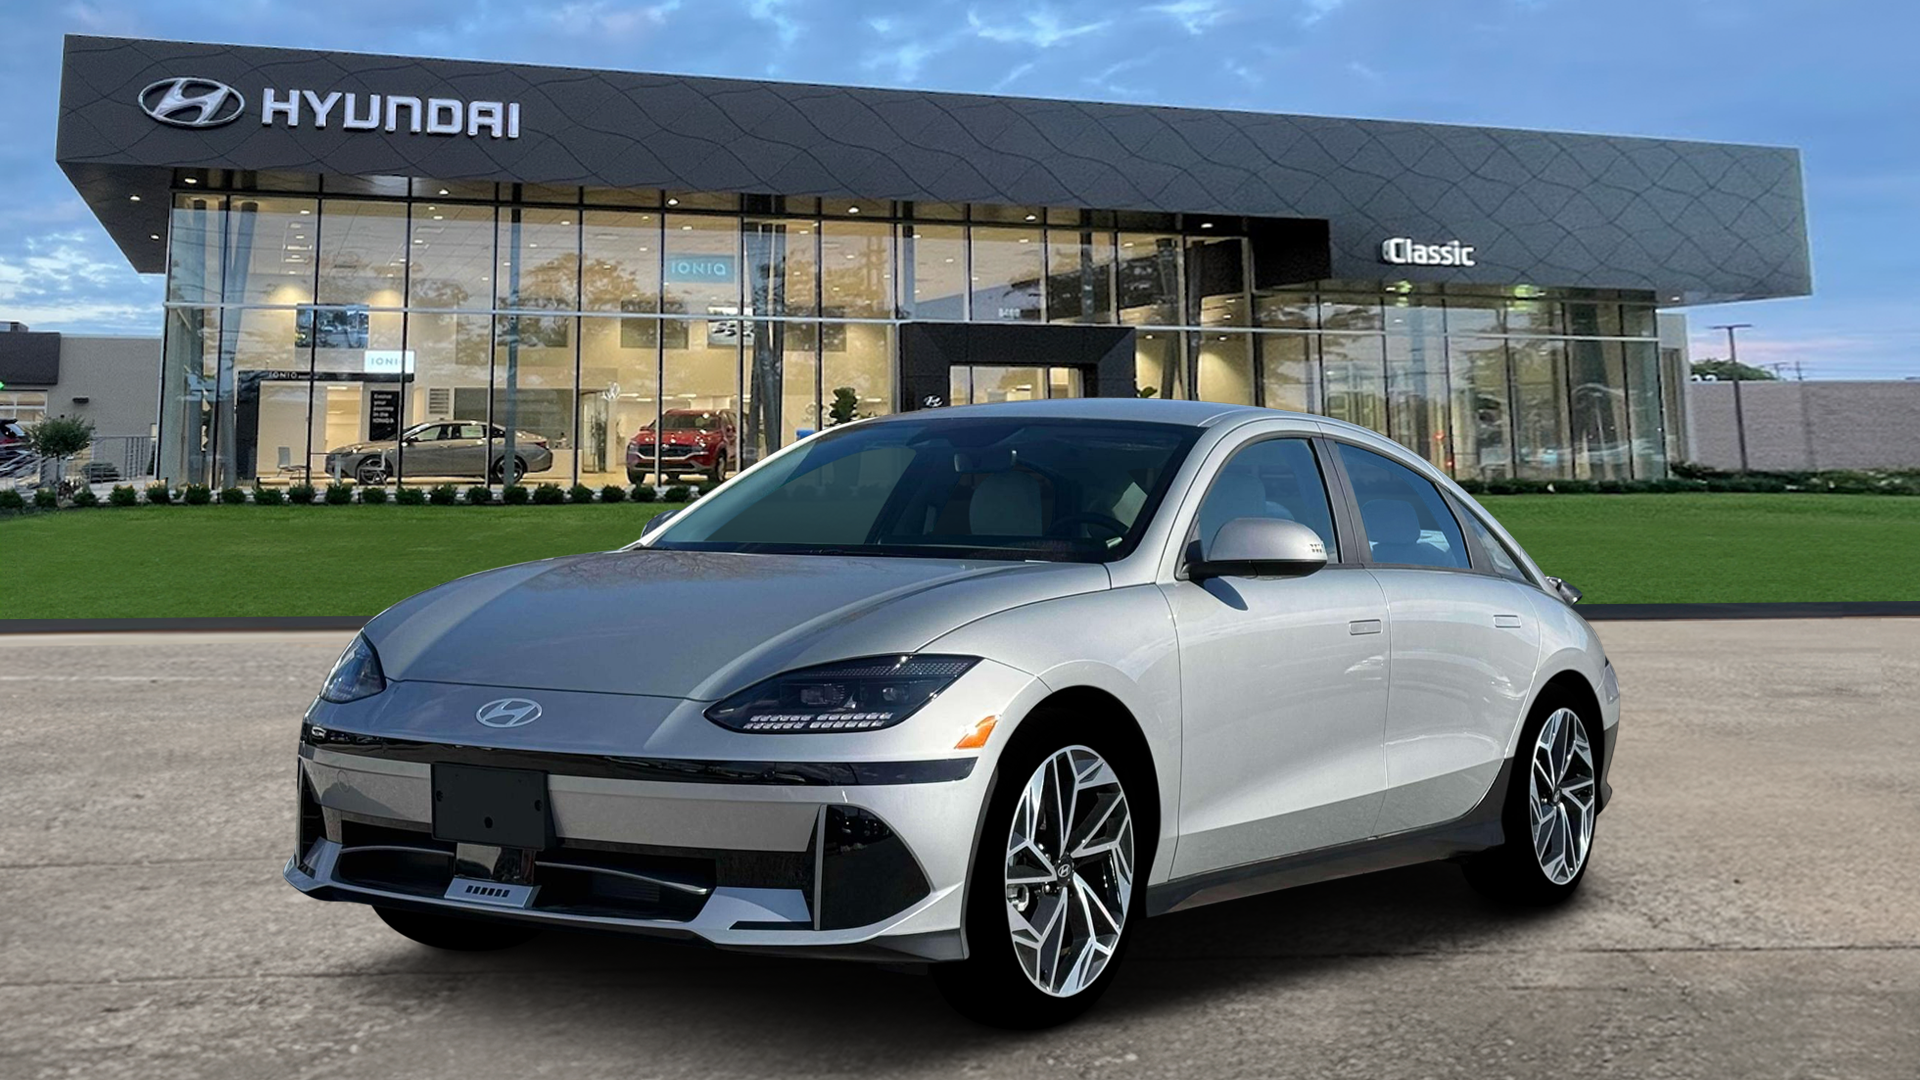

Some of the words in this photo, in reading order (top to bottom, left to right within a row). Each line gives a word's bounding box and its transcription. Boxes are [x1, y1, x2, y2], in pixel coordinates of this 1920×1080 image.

[261, 87, 521, 139] HYUNDAI
[1382, 237, 1476, 267] Classic
[671, 262, 726, 275] IONIQ
[371, 357, 402, 366] IONI
